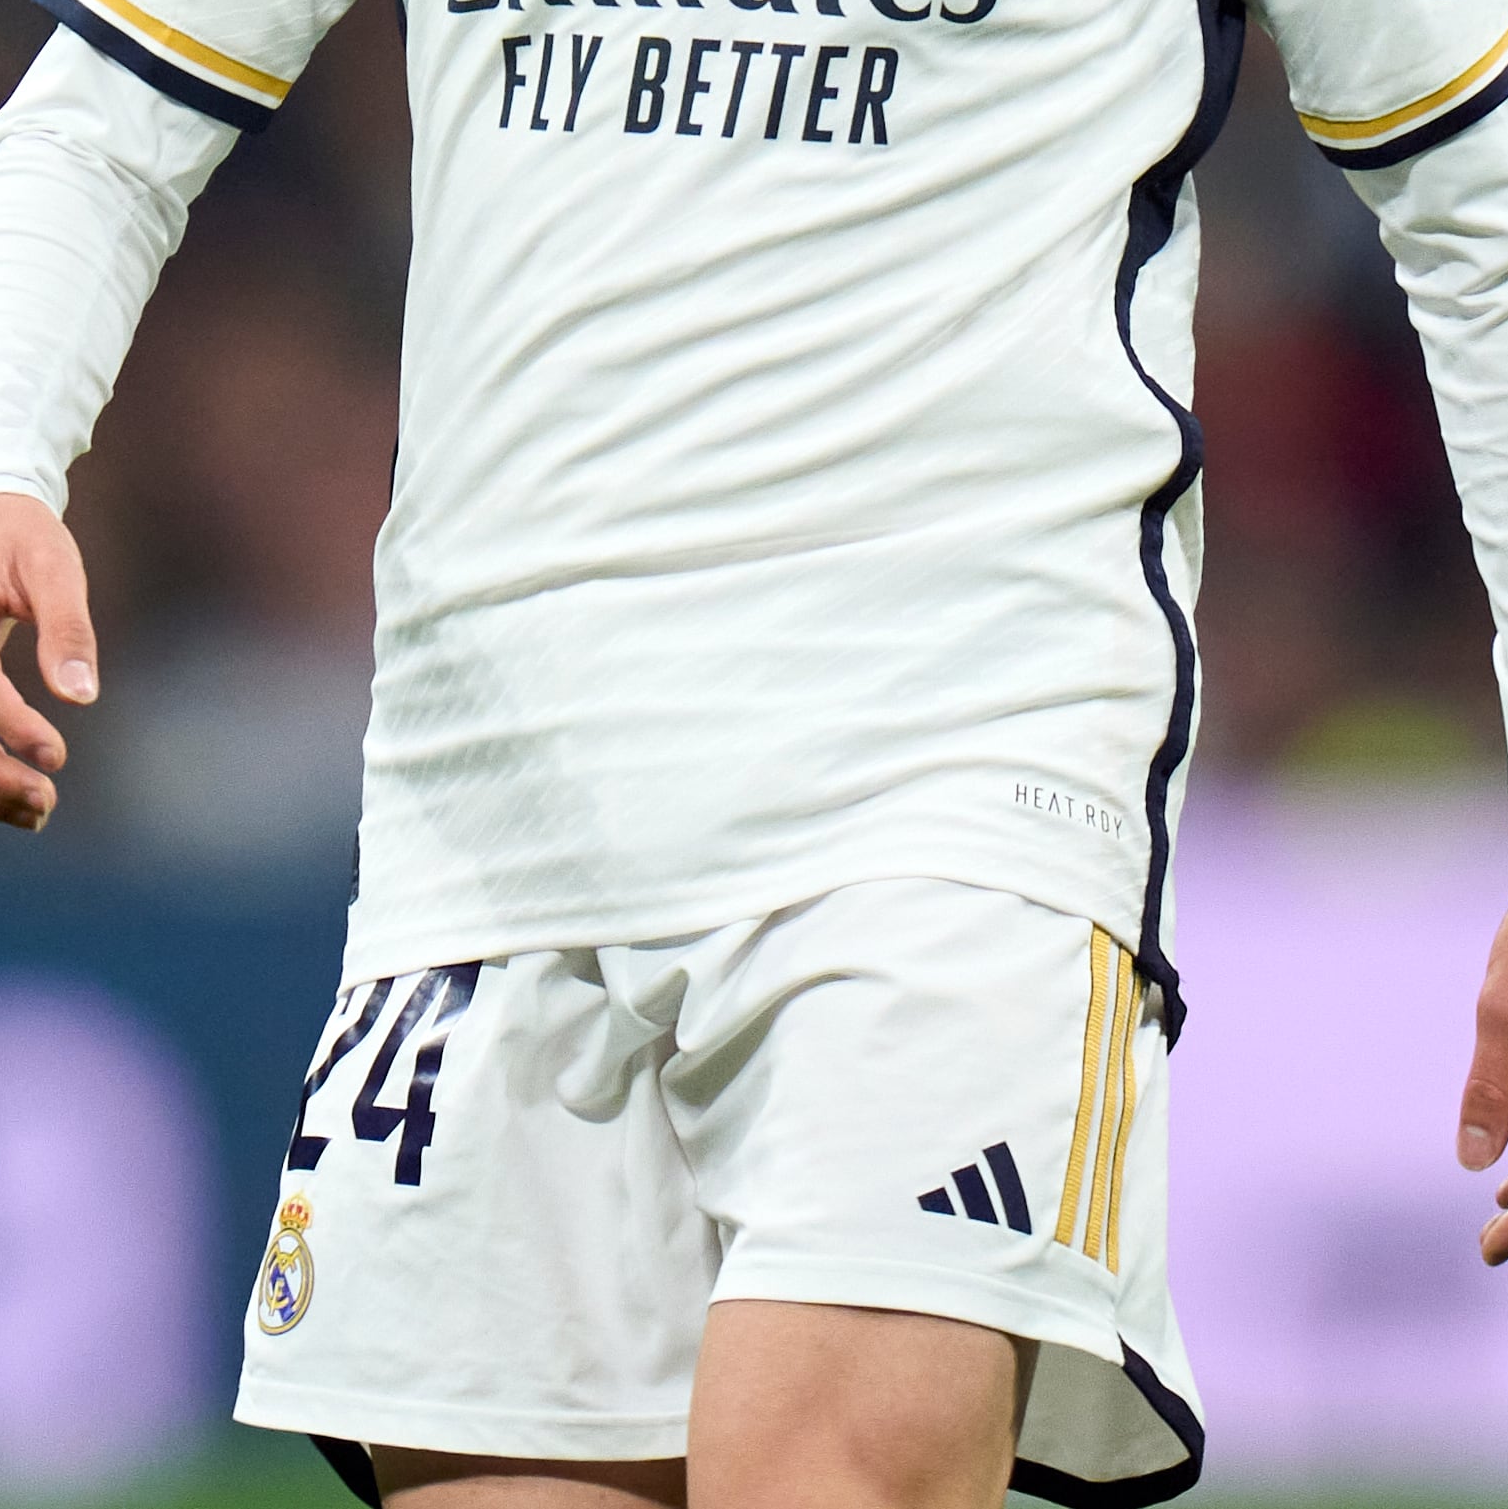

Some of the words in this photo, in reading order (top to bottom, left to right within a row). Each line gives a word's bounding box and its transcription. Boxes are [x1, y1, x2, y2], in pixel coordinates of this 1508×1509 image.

[499, 33, 603, 133] FLY
[622, 37, 899, 146] BETTER
[1014, 782, 1123, 840] HEAT.RDY
[287, 959, 483, 1187] 24
